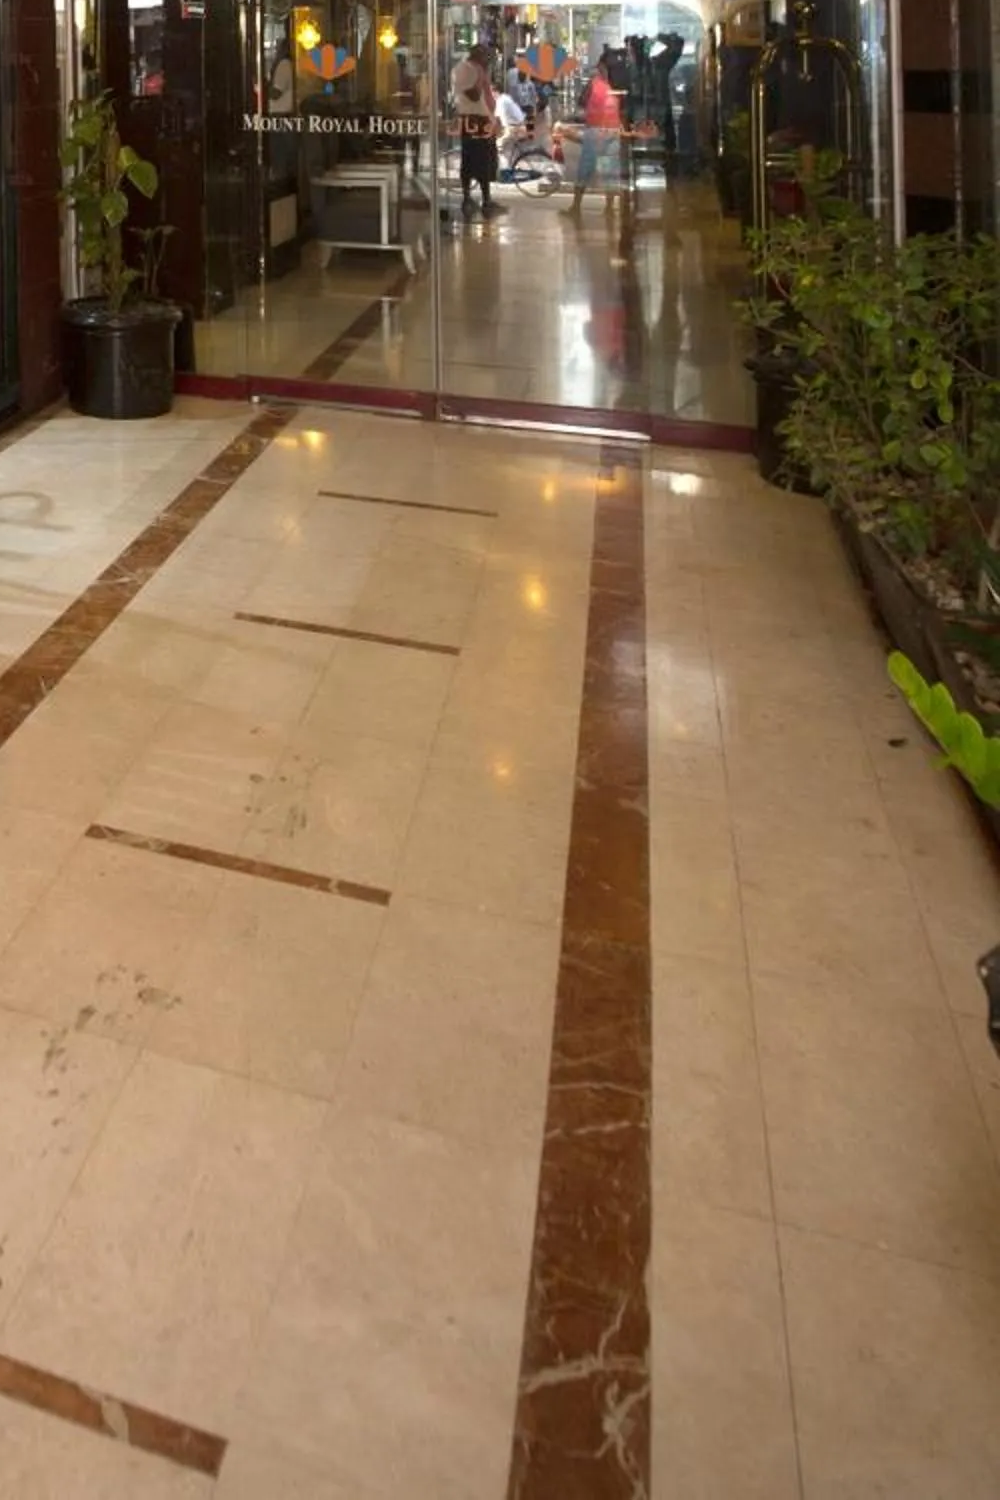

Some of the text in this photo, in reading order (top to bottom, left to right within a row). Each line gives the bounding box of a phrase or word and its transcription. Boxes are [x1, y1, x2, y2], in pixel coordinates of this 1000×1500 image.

[241, 113, 427, 136] MOUNT ROYAL HOTEL
